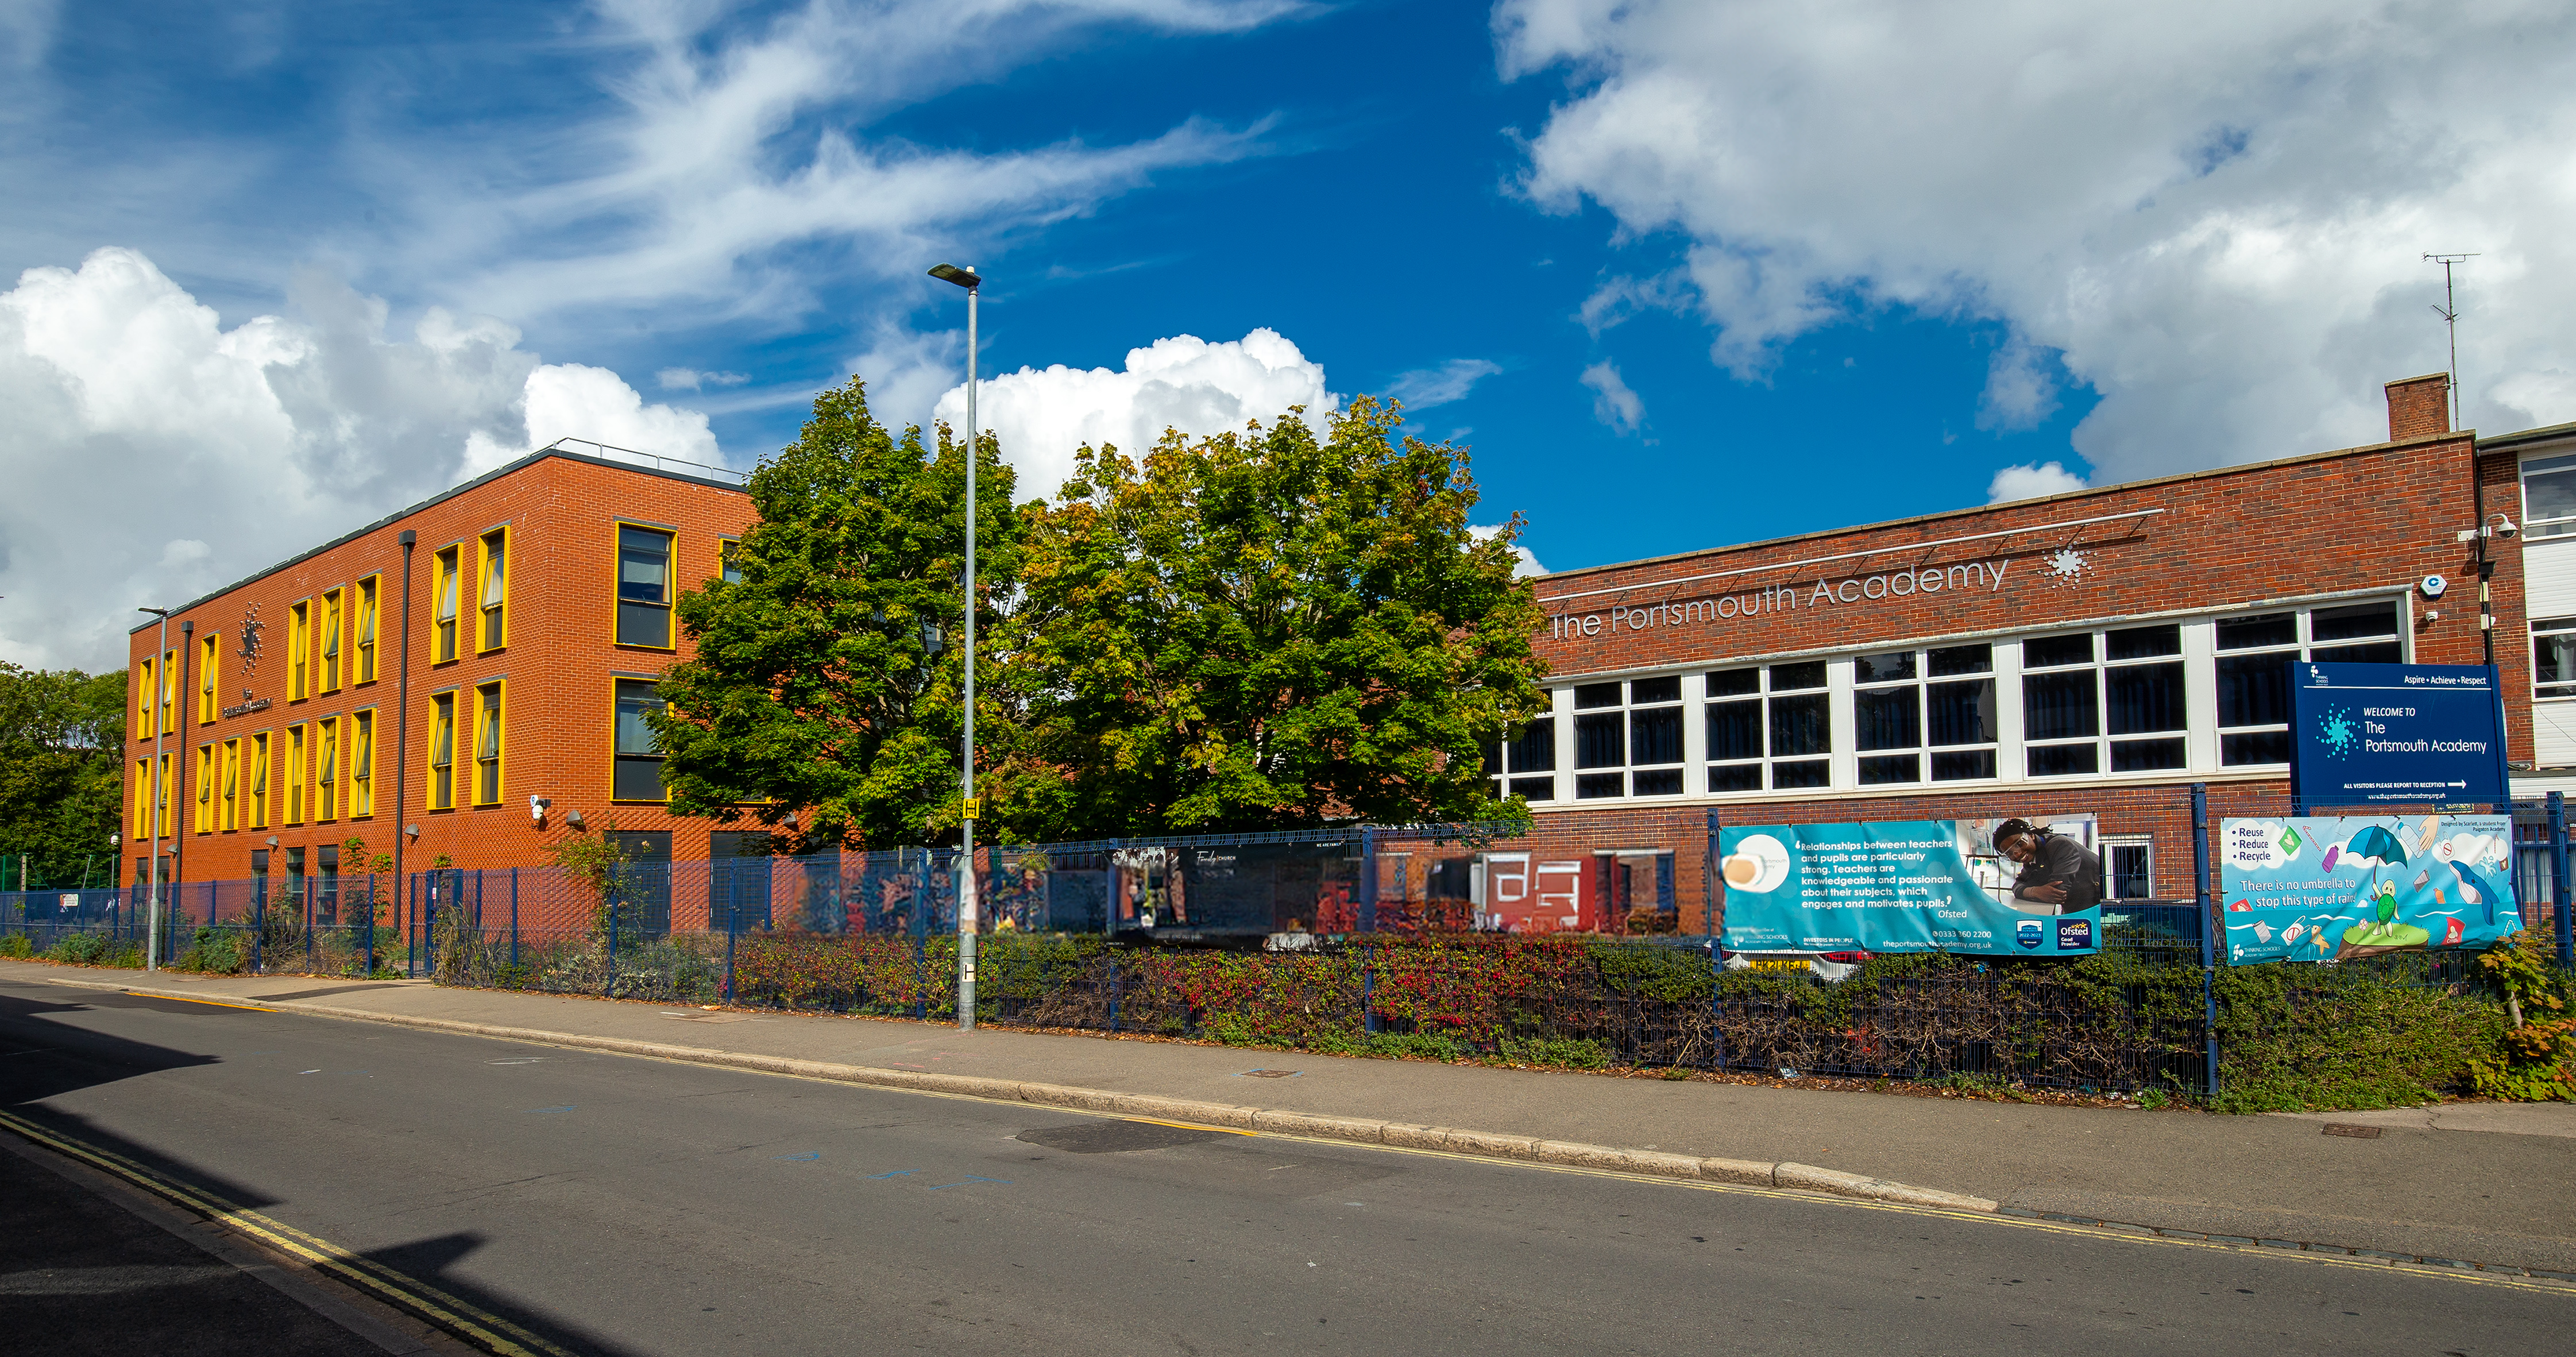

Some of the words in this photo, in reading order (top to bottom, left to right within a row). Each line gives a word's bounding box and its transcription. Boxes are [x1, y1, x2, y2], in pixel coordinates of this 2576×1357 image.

[1550, 612, 1601, 639] The
[1612, 583, 1795, 633] Portsmouth
[1809, 559, 2009, 607] Academy
[2404, 675, 2425, 685] Aspire
[2431, 676, 2456, 684] Achieve
[2461, 676, 2486, 686] Respect
[2364, 708, 2403, 716] WELCOME
[2405, 708, 2416, 716] TO
[2365, 721, 2385, 734] The
[2366, 739, 2428, 752] Portsmouth
[2432, 739, 2486, 754] Academy
[966, 801, 976, 816] H
[2239, 828, 2264, 836] Reuse
[1863, 841, 1906, 849] between
[1909, 840, 1953, 848] teachers
[2239, 839, 2268, 849] Reduce
[1821, 853, 1848, 863] pupils
[1871, 852, 1925, 862] particularly
[2240, 850, 2271, 862] Recycle
[1801, 865, 1830, 875] strong.
[1833, 865, 1877, 873] Teachers
[1801, 876, 1875, 886] knowledgeable
[1878, 876, 1895, 884] and
[1899, 876, 1953, 885] passionate
[2240, 880, 2273, 892] There
[2276, 880, 2284, 890] is
[2286, 881, 2299, 890] no
[2301, 878, 2342, 889] umbrella
[2345, 878, 2355, 888] to
[1801, 888, 1828, 897] about
[1830, 888, 1852, 896] their
[1854, 888, 1895, 897] subjects,
[1898, 887, 1928, 896] which
[1801, 900, 1843, 909] engages
[1845, 900, 1865, 908] and
[1868, 900, 1913, 908] motivates
[2256, 897, 2279, 909] stop
[2282, 895, 2301, 907] this
[2303, 895, 2324, 908] type
[2326, 893, 2335, 904] of
[2338, 892, 2357, 904] rain!
[1938, 910, 1967, 918] Ofsted
[2061, 927, 2088, 935] Ofsted
[1883, 940, 1992, 949] theportsmouthacademy.org.uk
[965, 965, 975, 980] H
